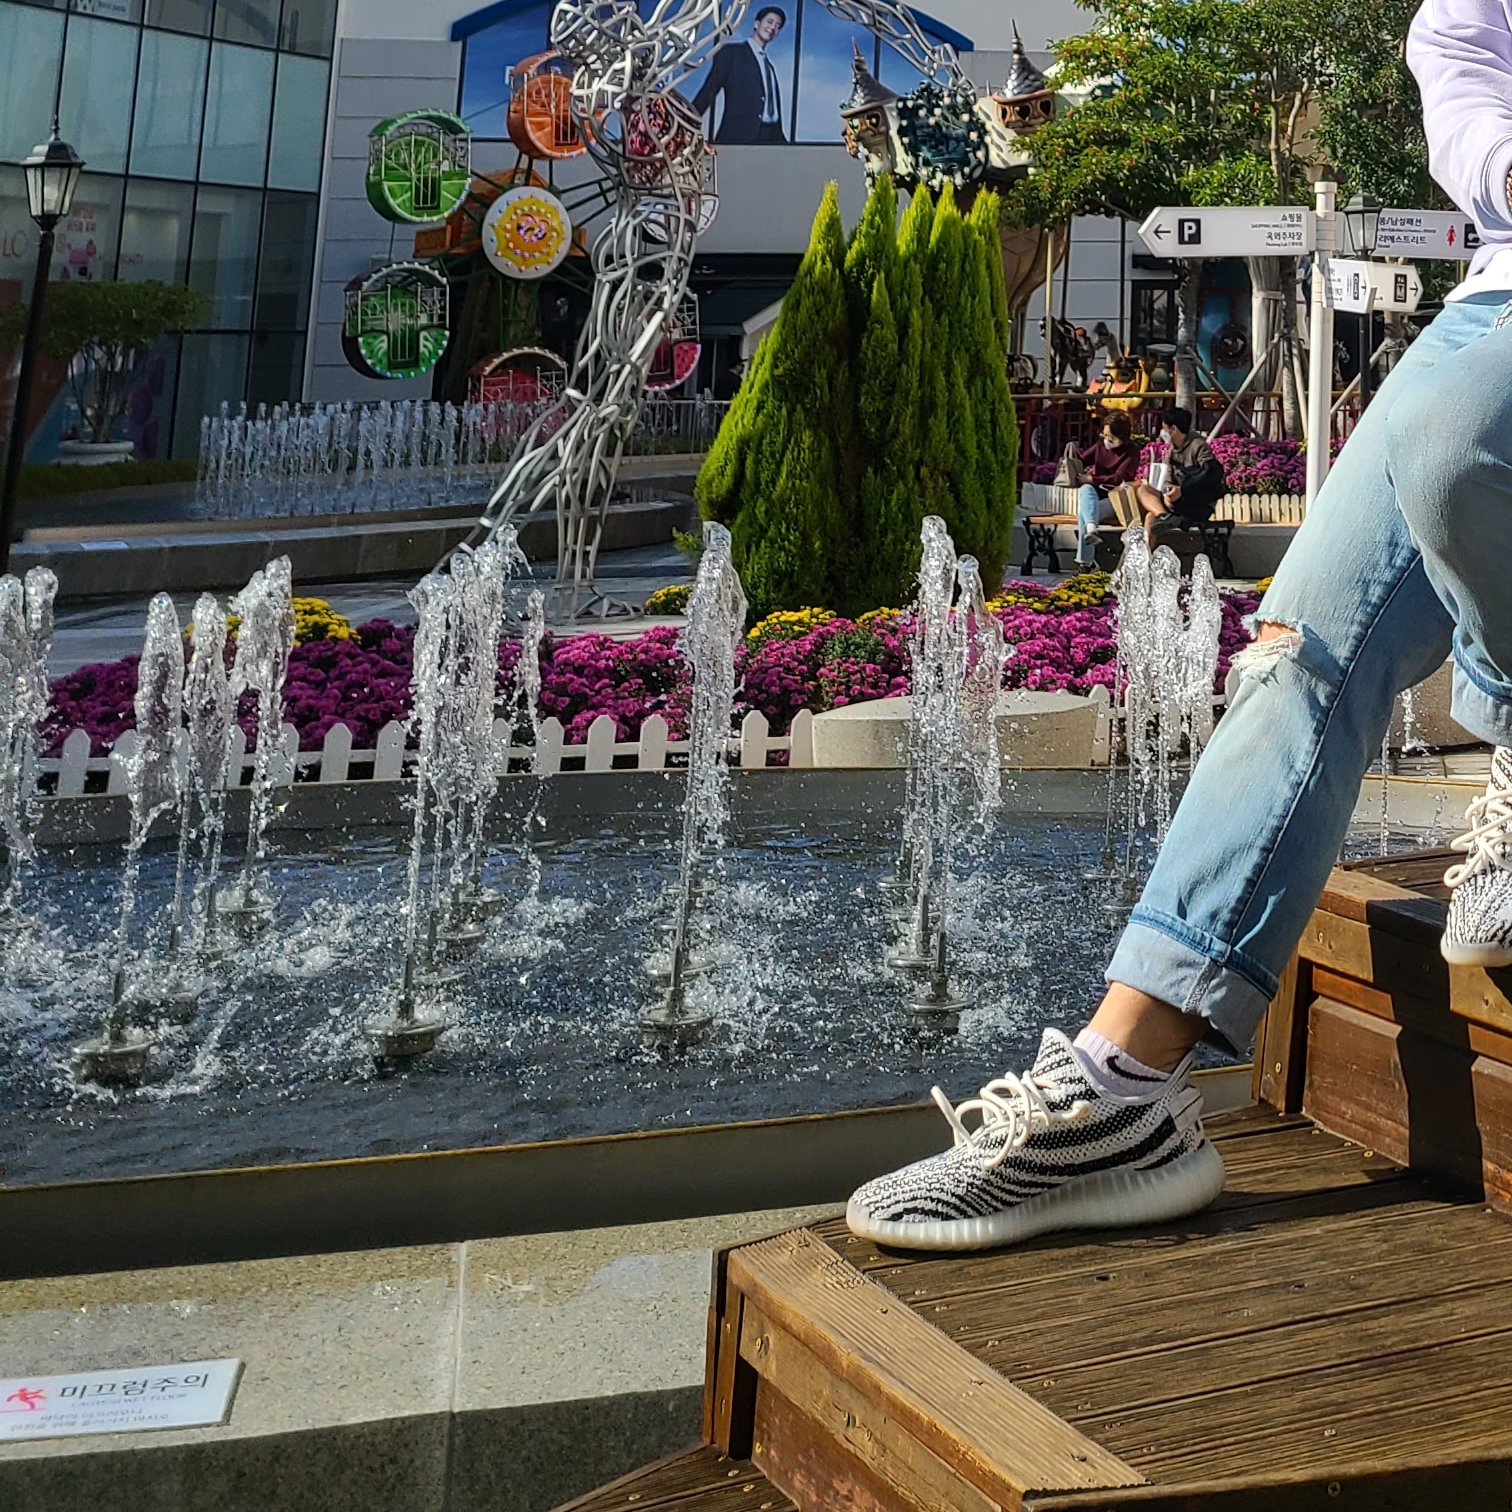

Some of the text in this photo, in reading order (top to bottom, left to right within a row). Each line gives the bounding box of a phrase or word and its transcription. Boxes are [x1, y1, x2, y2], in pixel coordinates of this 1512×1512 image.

[1281, 213, 1302, 223] 쇼핑몰
[1183, 221, 1196, 242] P
[1266, 231, 1302, 241] 옥외주차장
[59, 1372, 209, 1400] 미끄럼주의
